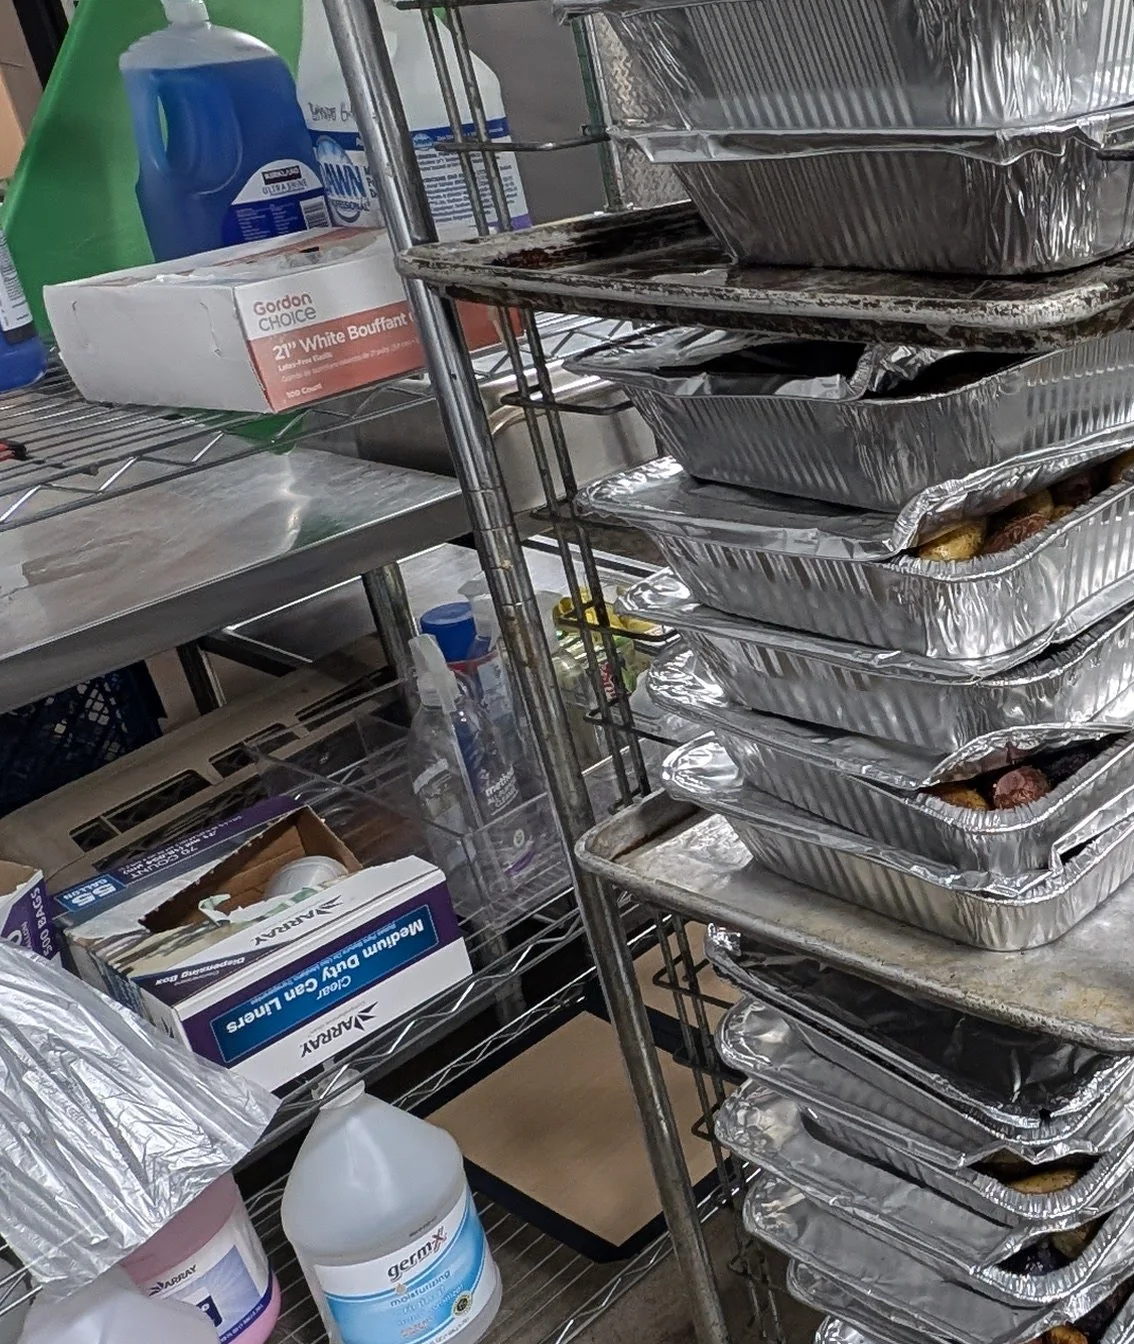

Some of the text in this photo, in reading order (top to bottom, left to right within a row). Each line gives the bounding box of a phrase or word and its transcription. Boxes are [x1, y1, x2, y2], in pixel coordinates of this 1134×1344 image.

[322, 163, 367, 198] AWN
[253, 292, 313, 316] Gordon
[300, 331, 346, 353] White
[347, 314, 407, 339] Bouffant
[130, 854, 179, 879] COUNT
[63, 878, 108, 900] GALLON
[72, 883, 117, 907] 55
[30, 887, 47, 929] BAGS
[253, 909, 317, 946] ARRAY
[362, 918, 425, 958] Medium
[155, 974, 179, 986] Box
[181, 957, 246, 978] Dispensing
[322, 956, 361, 981] Duty
[284, 977, 318, 1002] Can
[316, 975, 352, 1000] Clear
[226, 1000, 283, 1034] Liners
[300, 1016, 353, 1058] ARRAY
[165, 1264, 197, 1289] ARRAY
[390, 1269, 451, 1307] moisturizing
